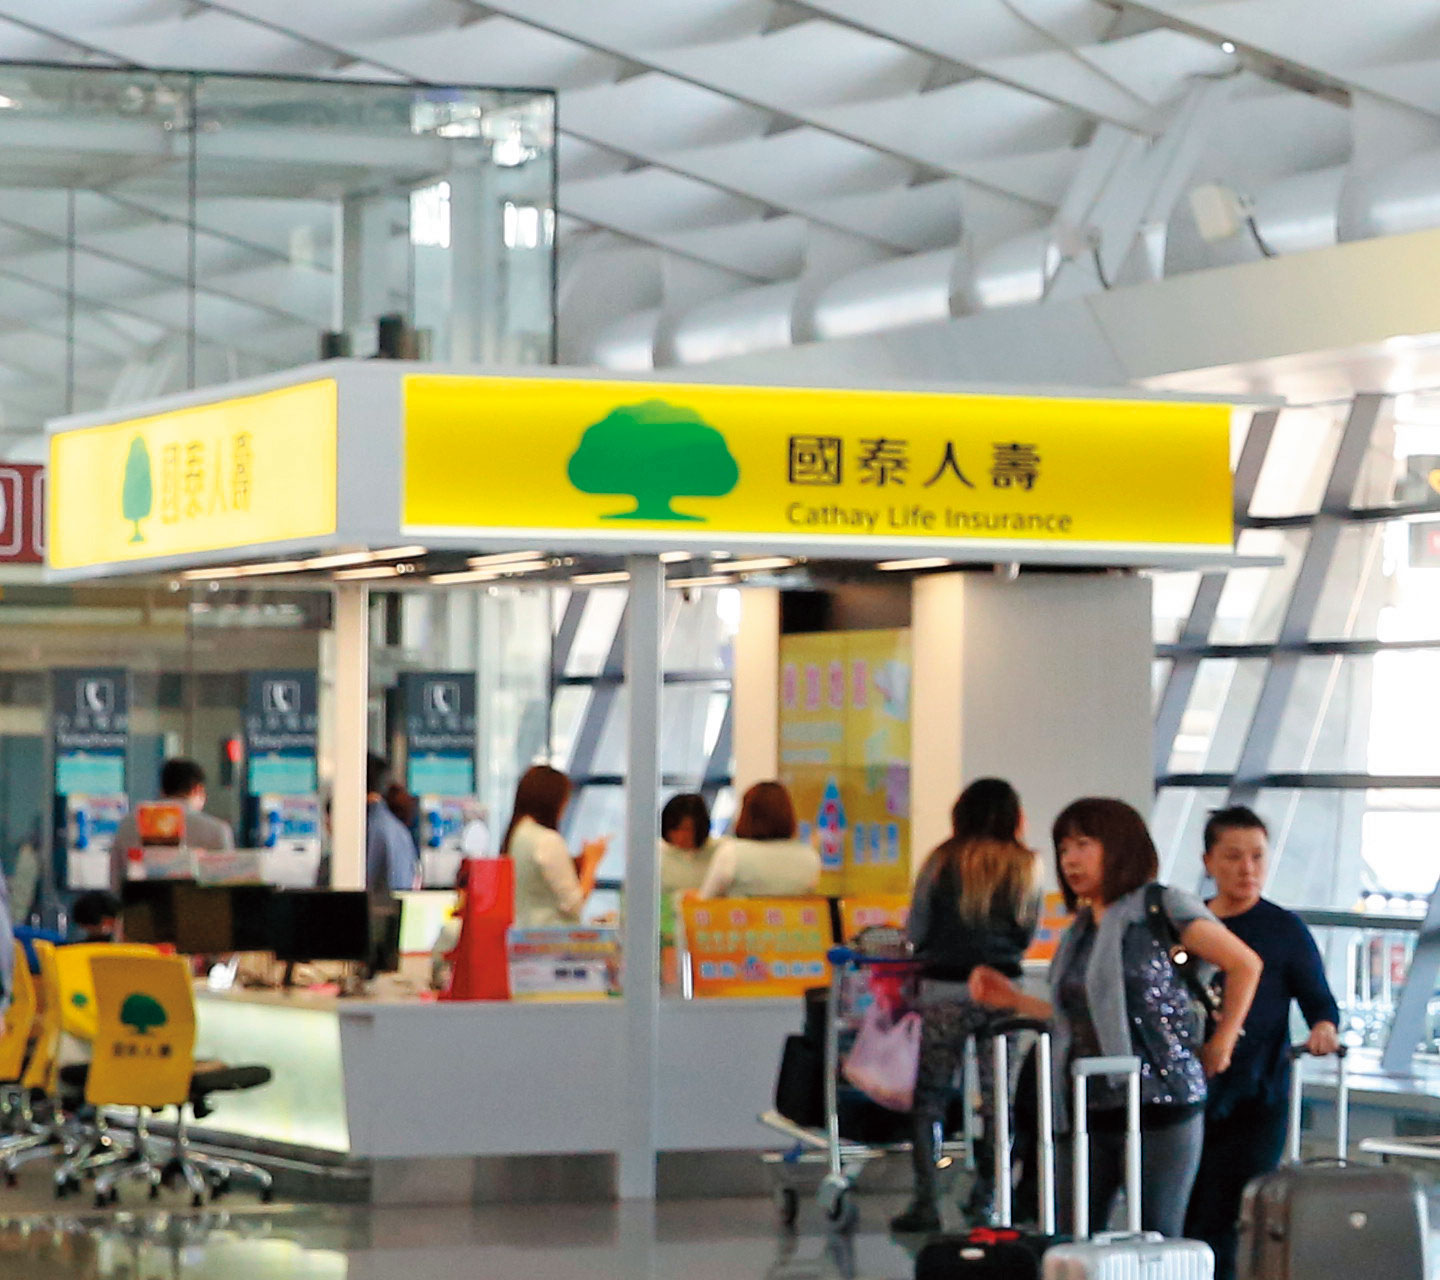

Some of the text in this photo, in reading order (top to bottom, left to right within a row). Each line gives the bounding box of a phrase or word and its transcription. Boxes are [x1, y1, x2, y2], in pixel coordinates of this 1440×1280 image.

[788, 434, 1041, 491] 國泰人壽
[786, 502, 1073, 534] Cathay Life Insurance
